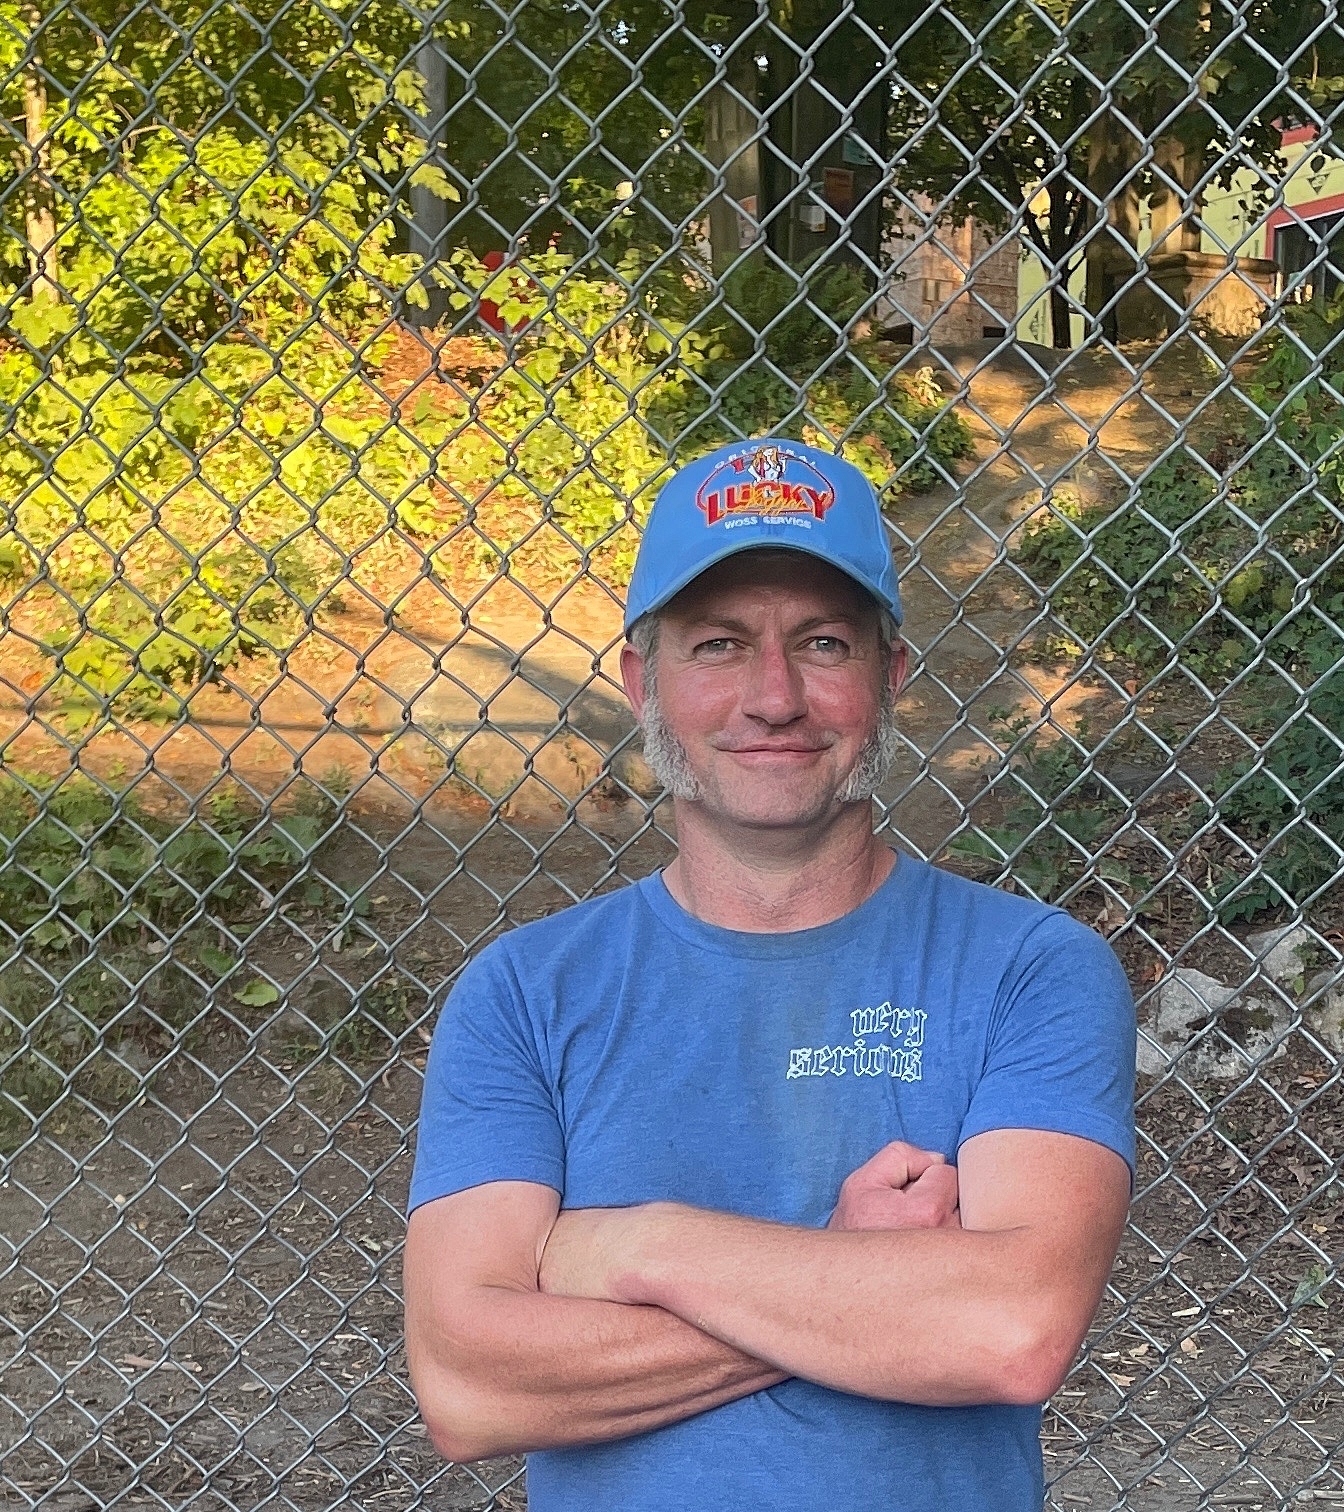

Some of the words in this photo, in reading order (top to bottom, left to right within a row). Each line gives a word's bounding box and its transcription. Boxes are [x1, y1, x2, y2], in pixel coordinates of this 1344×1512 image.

[706, 480, 831, 527] LUCKY
[763, 516, 812, 530] SERVICE
[850, 1001, 928, 1047] very
[786, 1038, 923, 1083] serious
